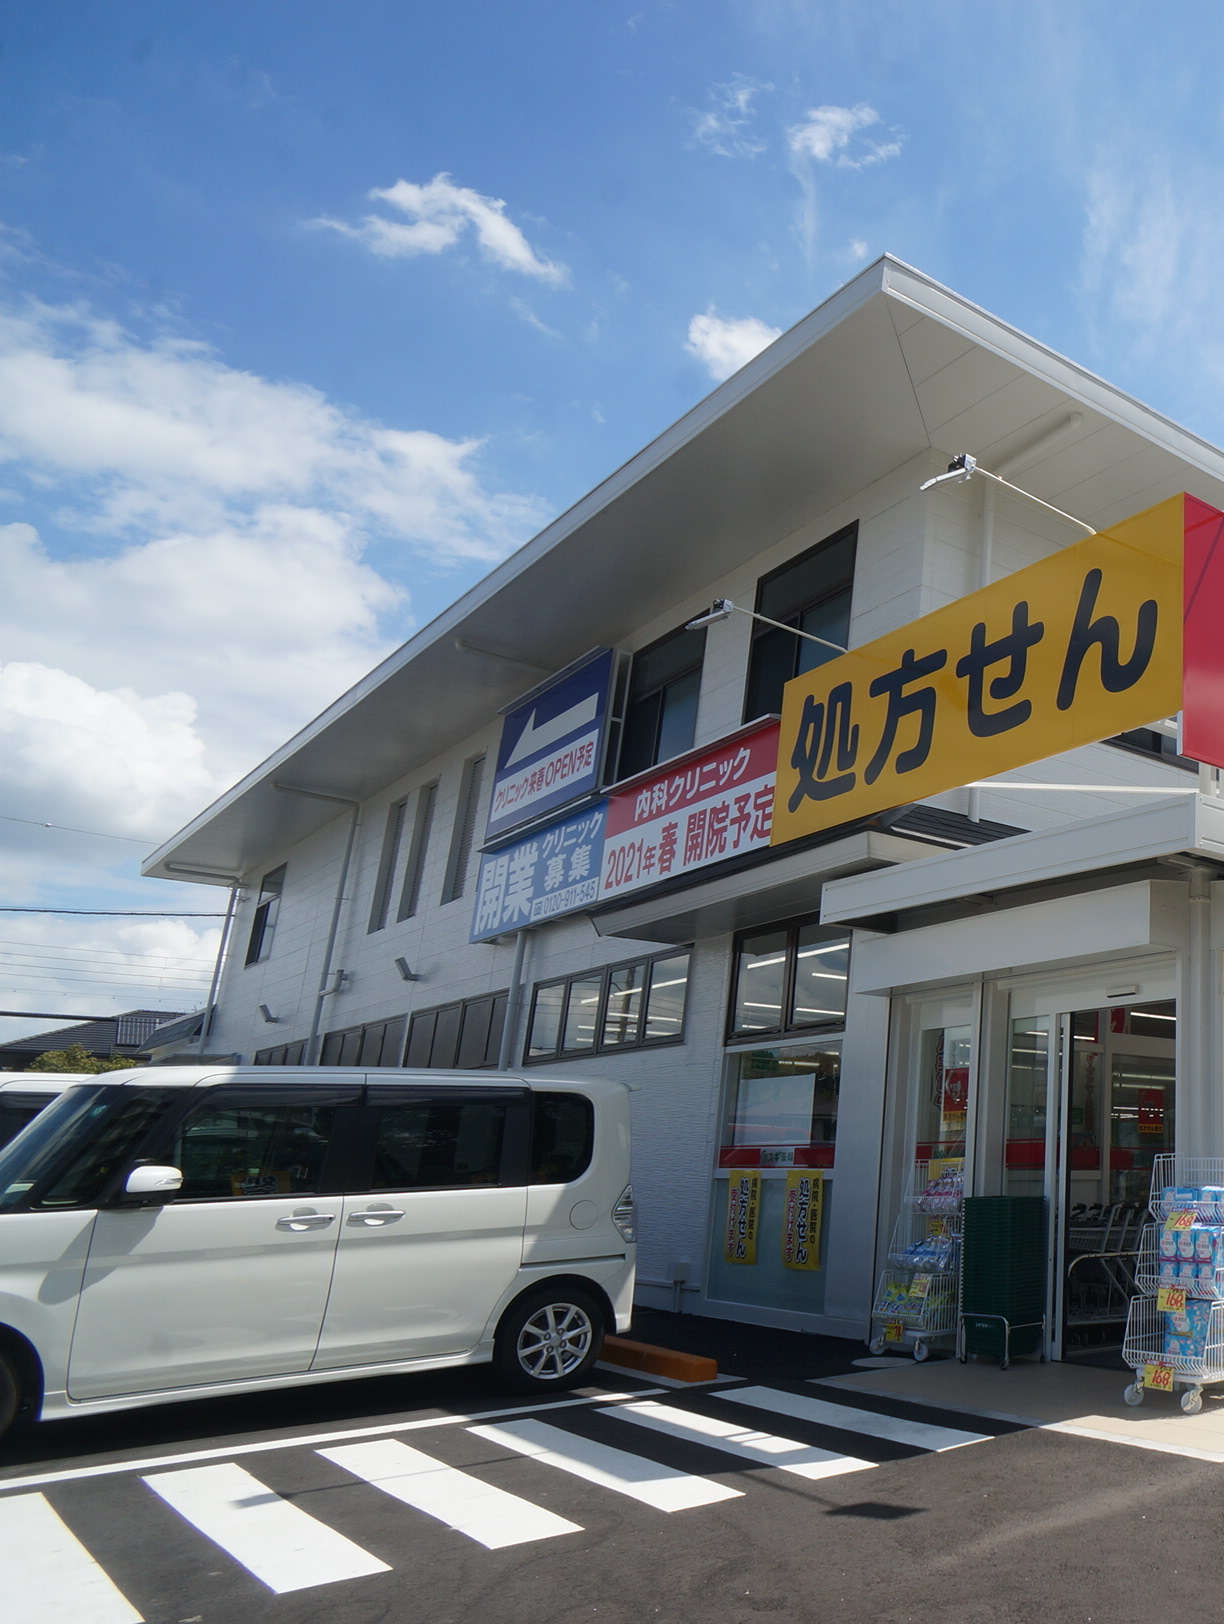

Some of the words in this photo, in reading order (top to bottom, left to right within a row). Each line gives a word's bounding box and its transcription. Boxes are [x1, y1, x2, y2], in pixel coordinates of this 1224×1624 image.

[788, 568, 1158, 813] 処方せん
[494, 740, 594, 813] クリニック来春OPEN予定
[634, 747, 751, 822] 内科クリニック
[542, 811, 604, 858] クリニック
[544, 844, 592, 891] 募集
[604, 821, 679, 890] 2021年春
[682, 784, 776, 867] 開院予定
[474, 841, 539, 936] 開業
[735, 1176, 750, 1260] 処方せん
[795, 1176, 811, 1264] 処方せん
[1174, 1215, 1194, 1228] 168
[1165, 1291, 1183, 1308] 168
[1152, 1371, 1170, 1386] 168
